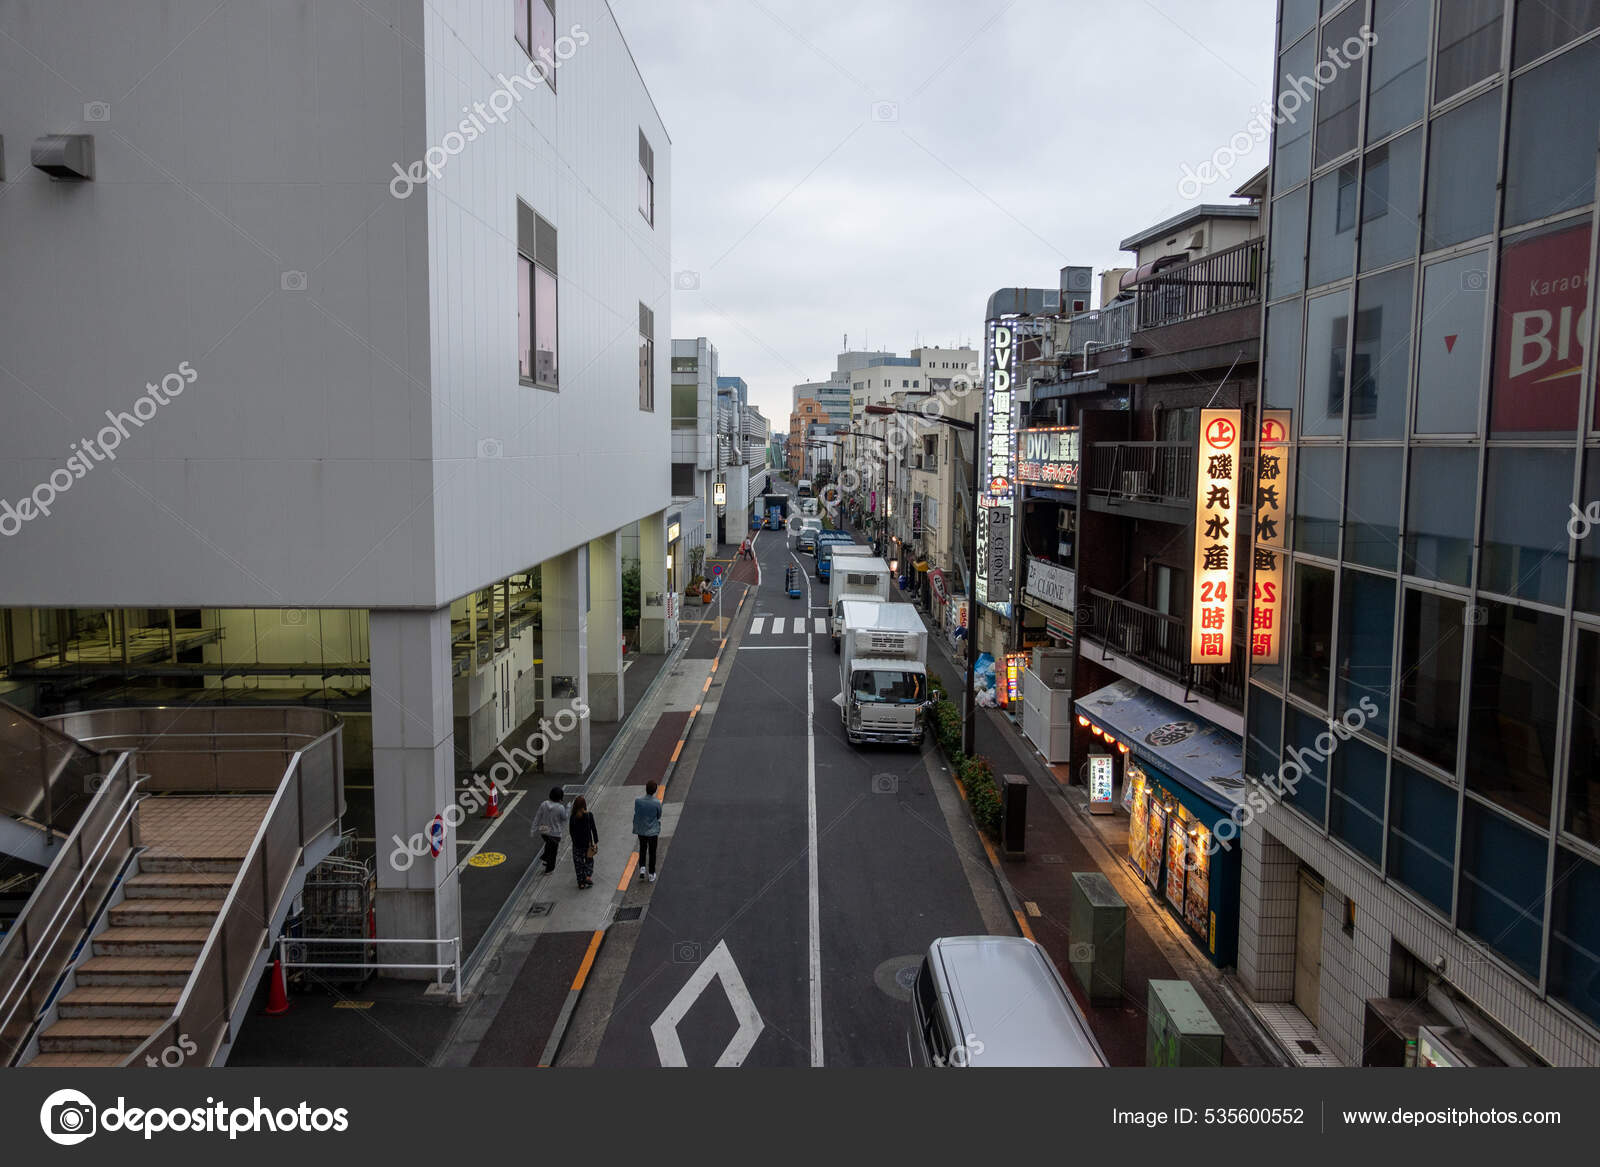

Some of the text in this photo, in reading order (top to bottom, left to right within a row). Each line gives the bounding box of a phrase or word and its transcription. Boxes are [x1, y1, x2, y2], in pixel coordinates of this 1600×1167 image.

[992, 511, 1009, 524] 2F
[1203, 453, 1232, 571] 磯丸水産
[993, 537, 1004, 585] CLIONE
[1038, 578, 1065, 601] CLIONE
[1199, 581, 1228, 657] 24時間
